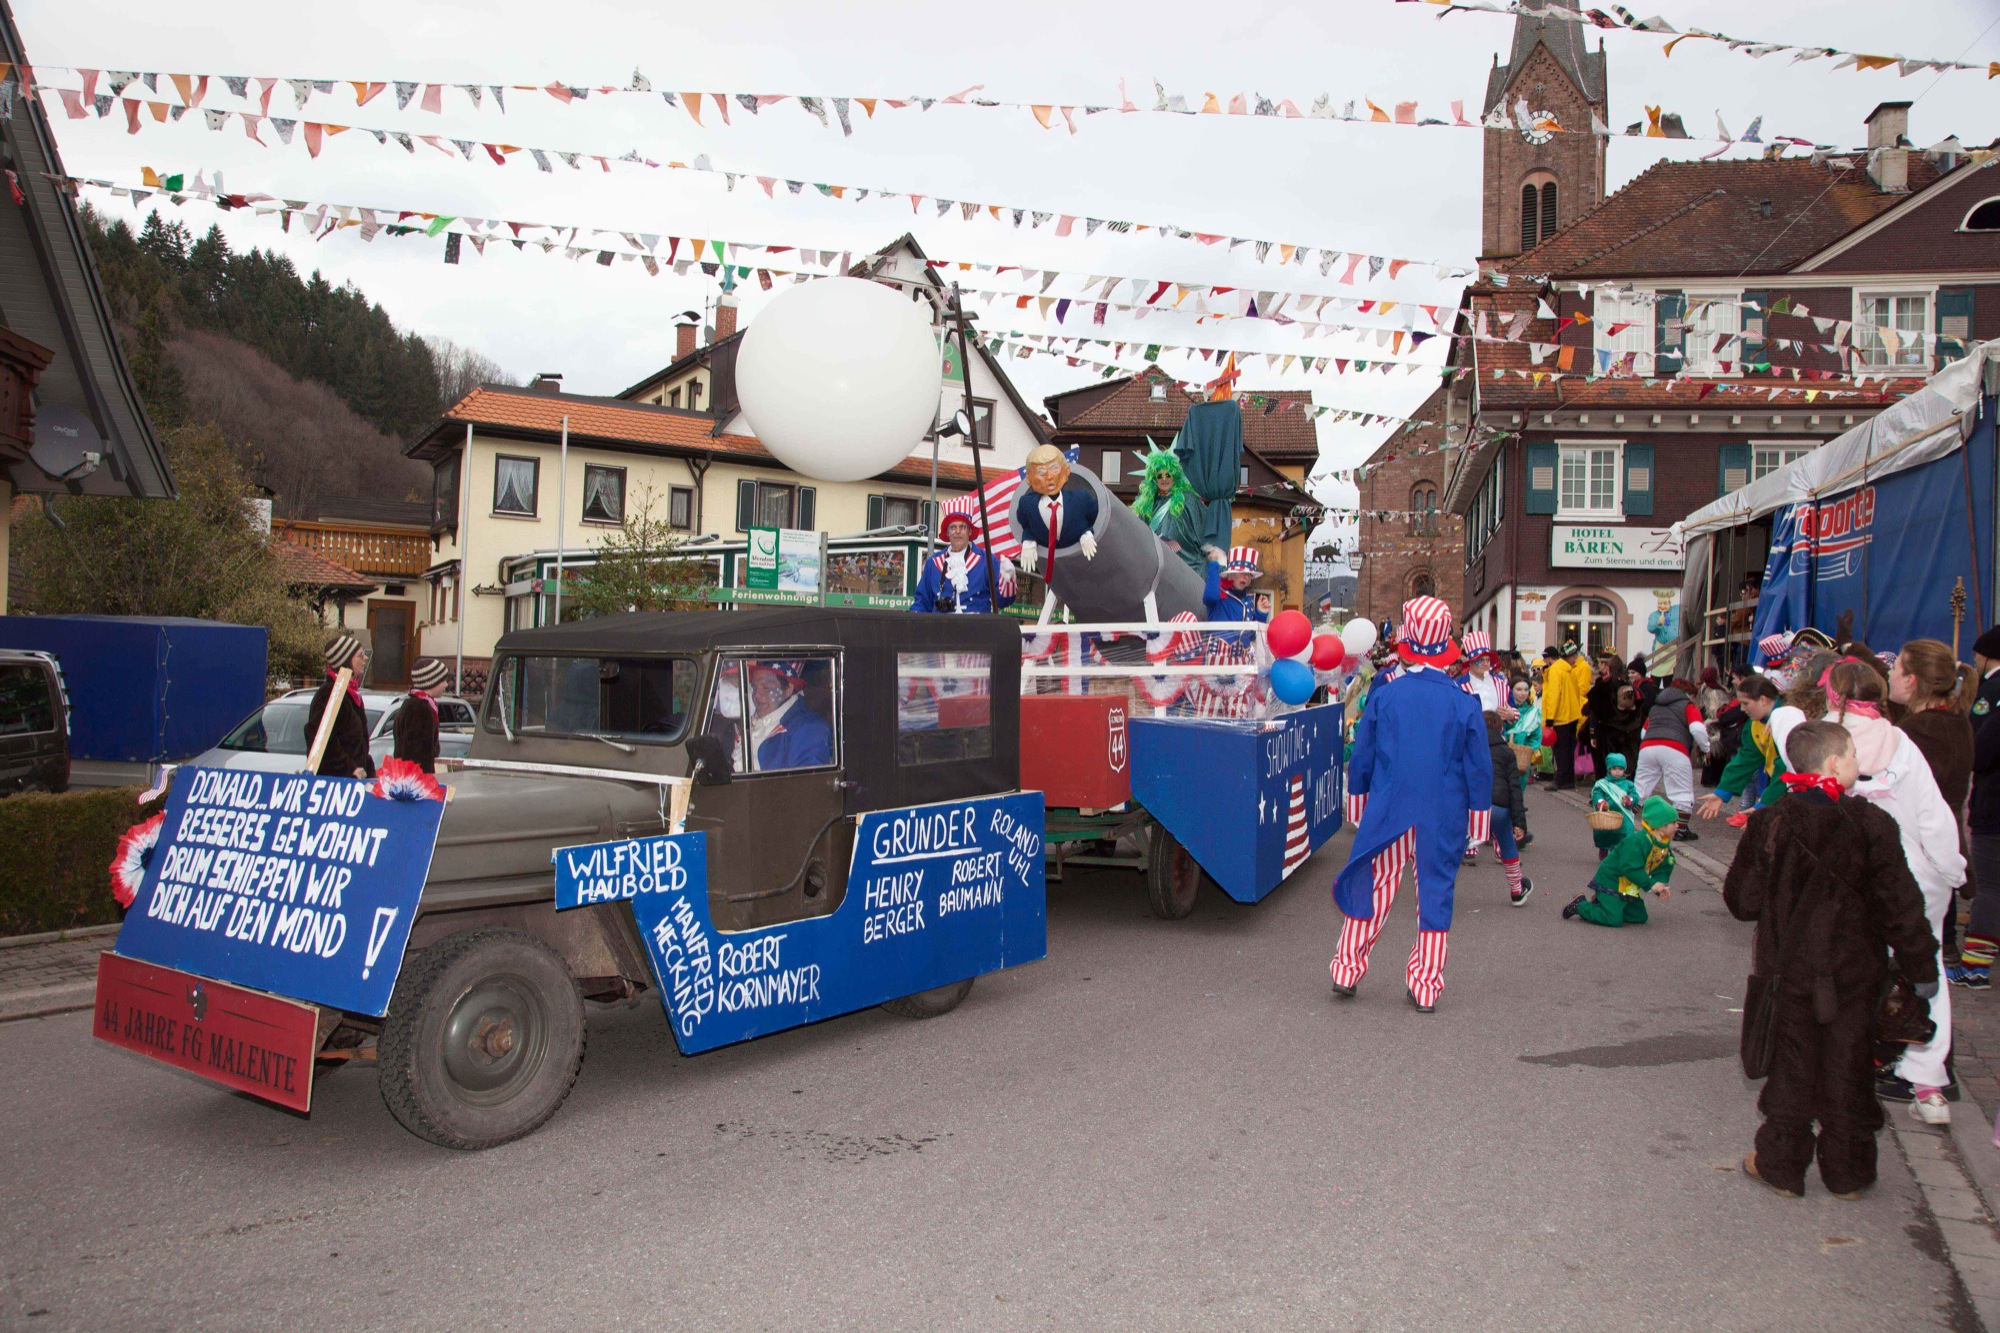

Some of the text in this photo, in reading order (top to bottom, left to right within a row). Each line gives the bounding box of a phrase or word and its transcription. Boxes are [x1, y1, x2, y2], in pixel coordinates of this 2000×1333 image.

[1564, 538, 1623, 554] BÄREN
[1571, 528, 1614, 538] HOTEL
[1584, 556, 1602, 564] Zum
[1606, 556, 1636, 565] Sternen
[1658, 558, 1673, 566] den
[1112, 734, 1124, 762] 44
[1266, 724, 1305, 779] SHOWTIME
[269, 778, 309, 813] WIR
[306, 780, 366, 817] SIND
[1314, 765, 1340, 829] AMERICA
[176, 808, 388, 867] BESSERES GEWOHNT
[873, 806, 977, 859] GRÜNDER
[990, 808, 1040, 858] ROLAND
[160, 845, 214, 886] DRUM
[304, 863, 351, 908] WIR
[567, 840, 681, 880] WILFRIED
[952, 851, 1003, 886] ROBERT
[1008, 846, 1031, 887] UHL
[577, 865, 687, 904] HAUBOLD
[864, 868, 924, 910] HENRY
[939, 876, 1004, 917] BAUMANN
[148, 881, 346, 958] DICH AUF DEN MOND
[864, 900, 925, 944] BERGER
[653, 916, 701, 1037] HECKING
[671, 895, 714, 1016] MANFRED
[718, 934, 788, 978] ROBERT
[718, 964, 820, 1014] KORNMAYER
[103, 999, 297, 1094] 44 JAHRE FG MALENTE
